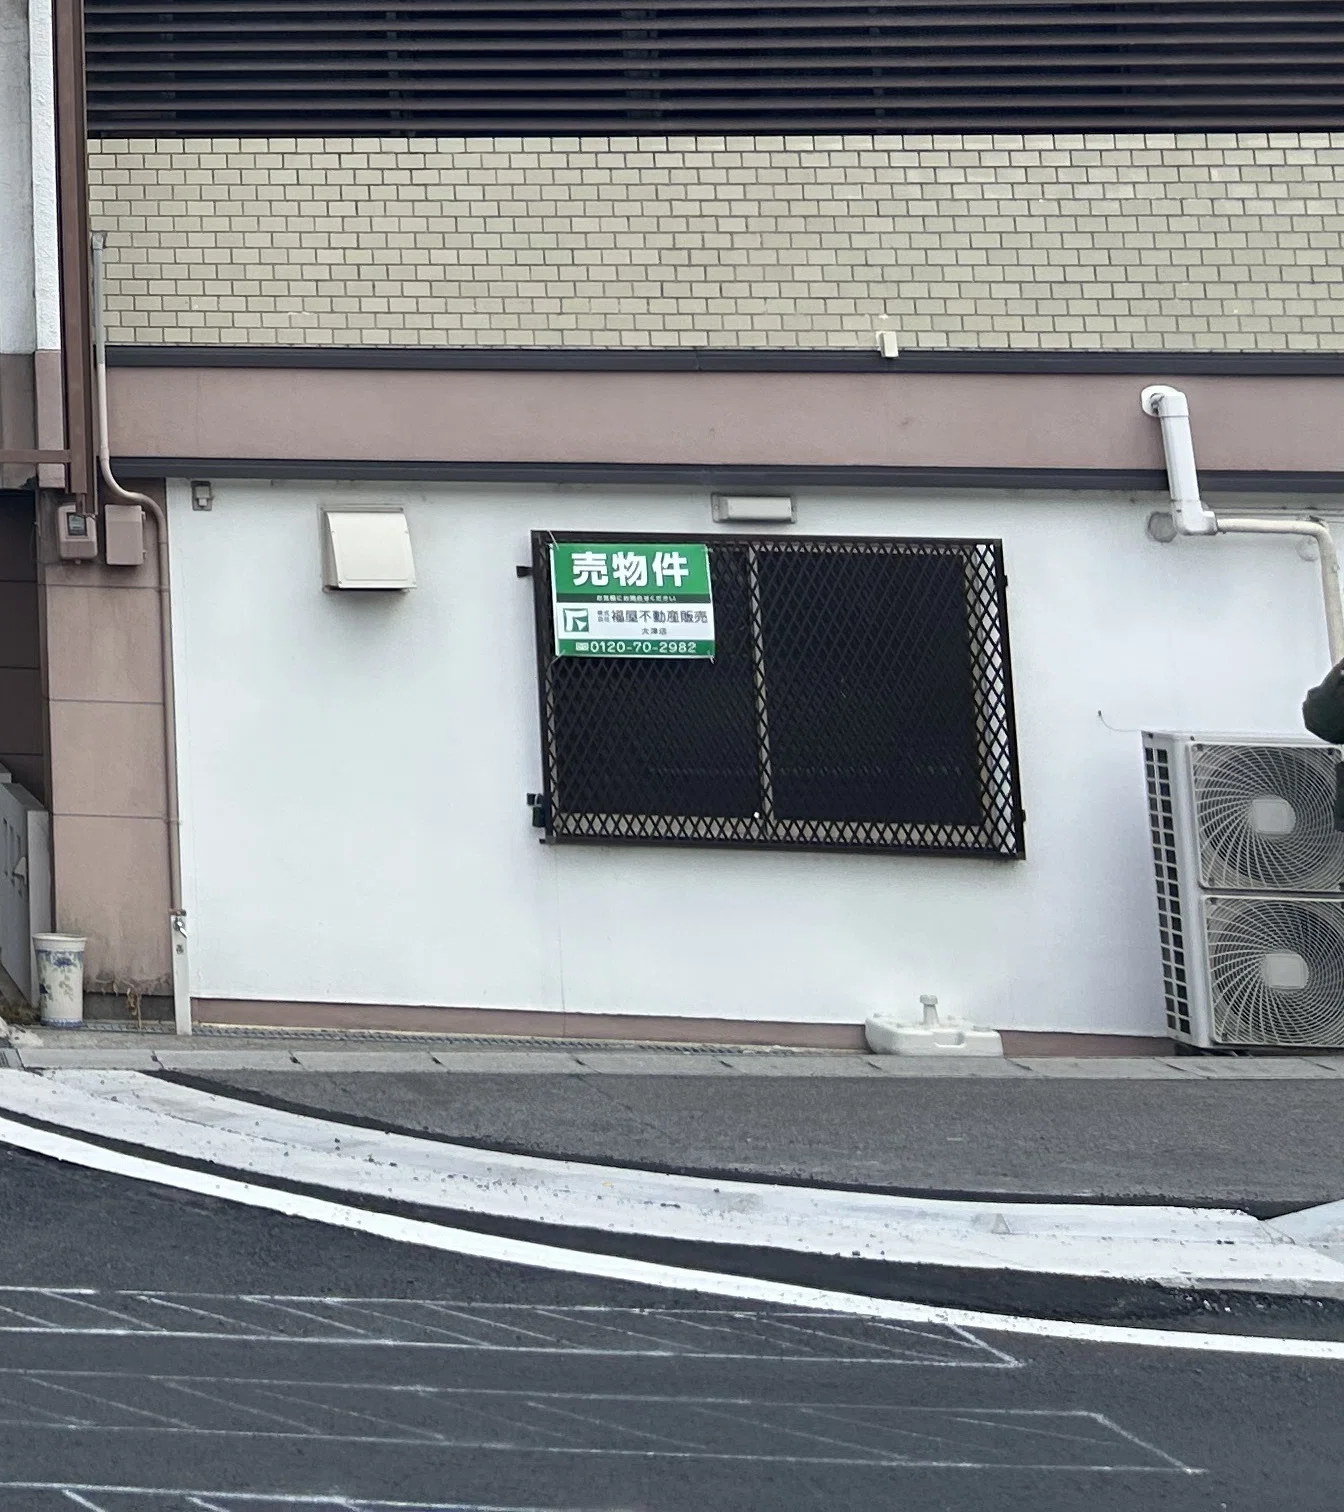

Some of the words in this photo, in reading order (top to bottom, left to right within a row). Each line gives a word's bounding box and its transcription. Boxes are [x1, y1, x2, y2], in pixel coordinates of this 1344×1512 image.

[571, 550, 690, 587] 売物件
[611, 609, 708, 624] 福屋不動産販売
[590, 641, 697, 653] 0120-70-2982
